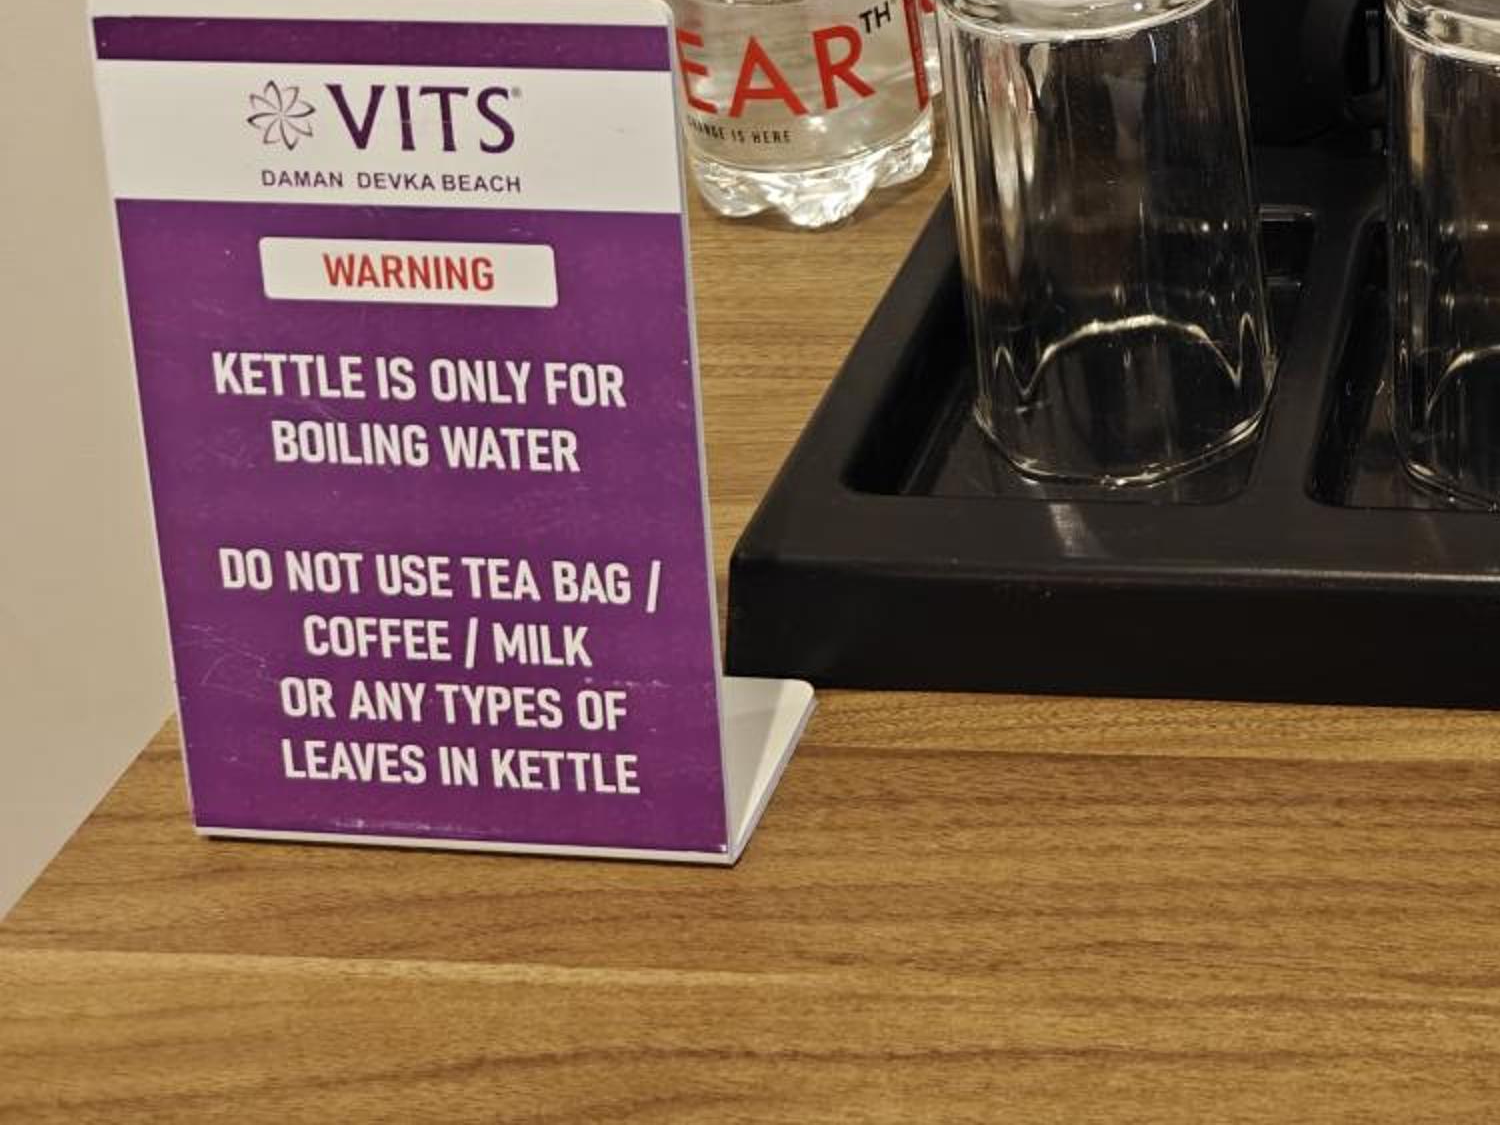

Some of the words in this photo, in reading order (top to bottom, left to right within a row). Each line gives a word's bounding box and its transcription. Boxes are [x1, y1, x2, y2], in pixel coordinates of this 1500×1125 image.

[325, 84, 515, 154] VITS
[731, 129, 745, 143] IS
[752, 129, 792, 144] HERE
[261, 170, 343, 188] DAMAN
[357, 172, 436, 190] DEVKA
[441, 174, 521, 193] BEACH
[323, 253, 494, 292] WARNING
[212, 351, 366, 399] KETTLE
[375, 356, 417, 401] IS
[430, 358, 531, 404] ONLY
[544, 362, 627, 408] FOR
[271, 420, 429, 467] BOILING
[439, 425, 581, 472] WATER
[219, 548, 273, 590] DO
[285, 550, 363, 594] NOT
[375, 554, 453, 598] USE
[461, 557, 541, 601] TEA
[552, 560, 631, 605] BAG
[303, 614, 452, 661] COFFEE
[492, 622, 593, 667] MILK
[280, 676, 336, 718] OR
[349, 680, 426, 722] ANY
[435, 683, 563, 729] TYPES
[577, 690, 627, 731] OF
[281, 738, 427, 784] LEAVES
[439, 746, 479, 787] IN
[491, 748, 641, 794] KETTLE
